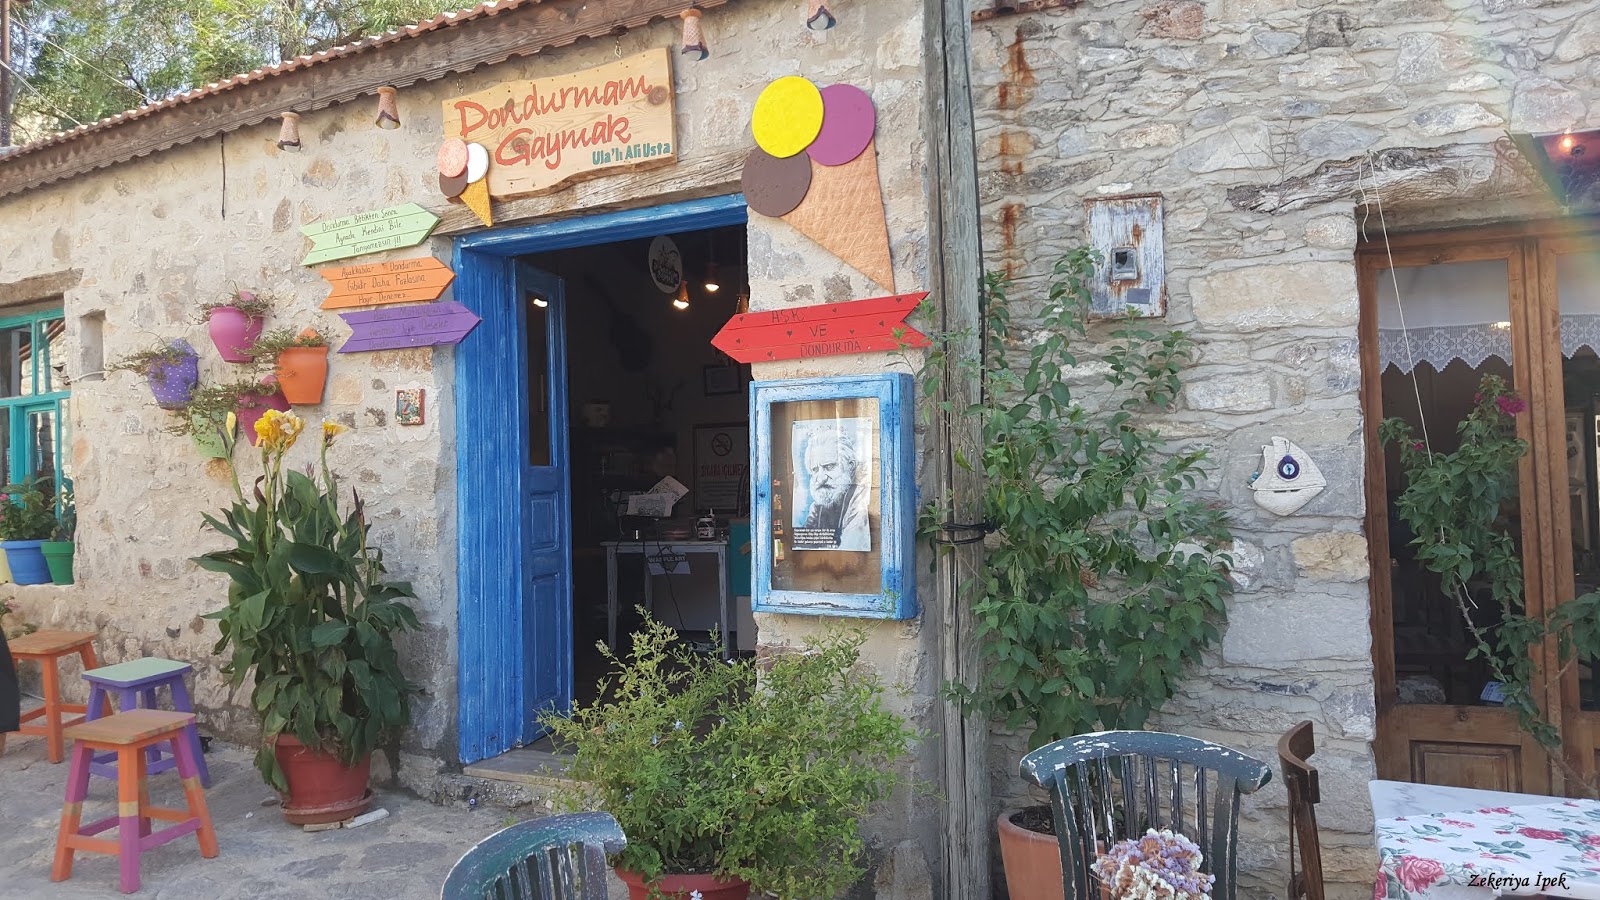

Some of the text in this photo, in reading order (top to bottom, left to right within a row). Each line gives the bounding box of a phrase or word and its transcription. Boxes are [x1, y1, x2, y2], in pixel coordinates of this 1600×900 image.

[454, 75, 653, 138] Dondurmam
[495, 114, 632, 170] Gaymak
[625, 143, 642, 160] Ali
[643, 142, 671, 157] Usta
[322, 219, 350, 232] Dondurma
[388, 219, 402, 231] Bile
[372, 277, 390, 288] Daha
[809, 323, 828, 337] VE
[800, 341, 861, 357] DONDURMA
